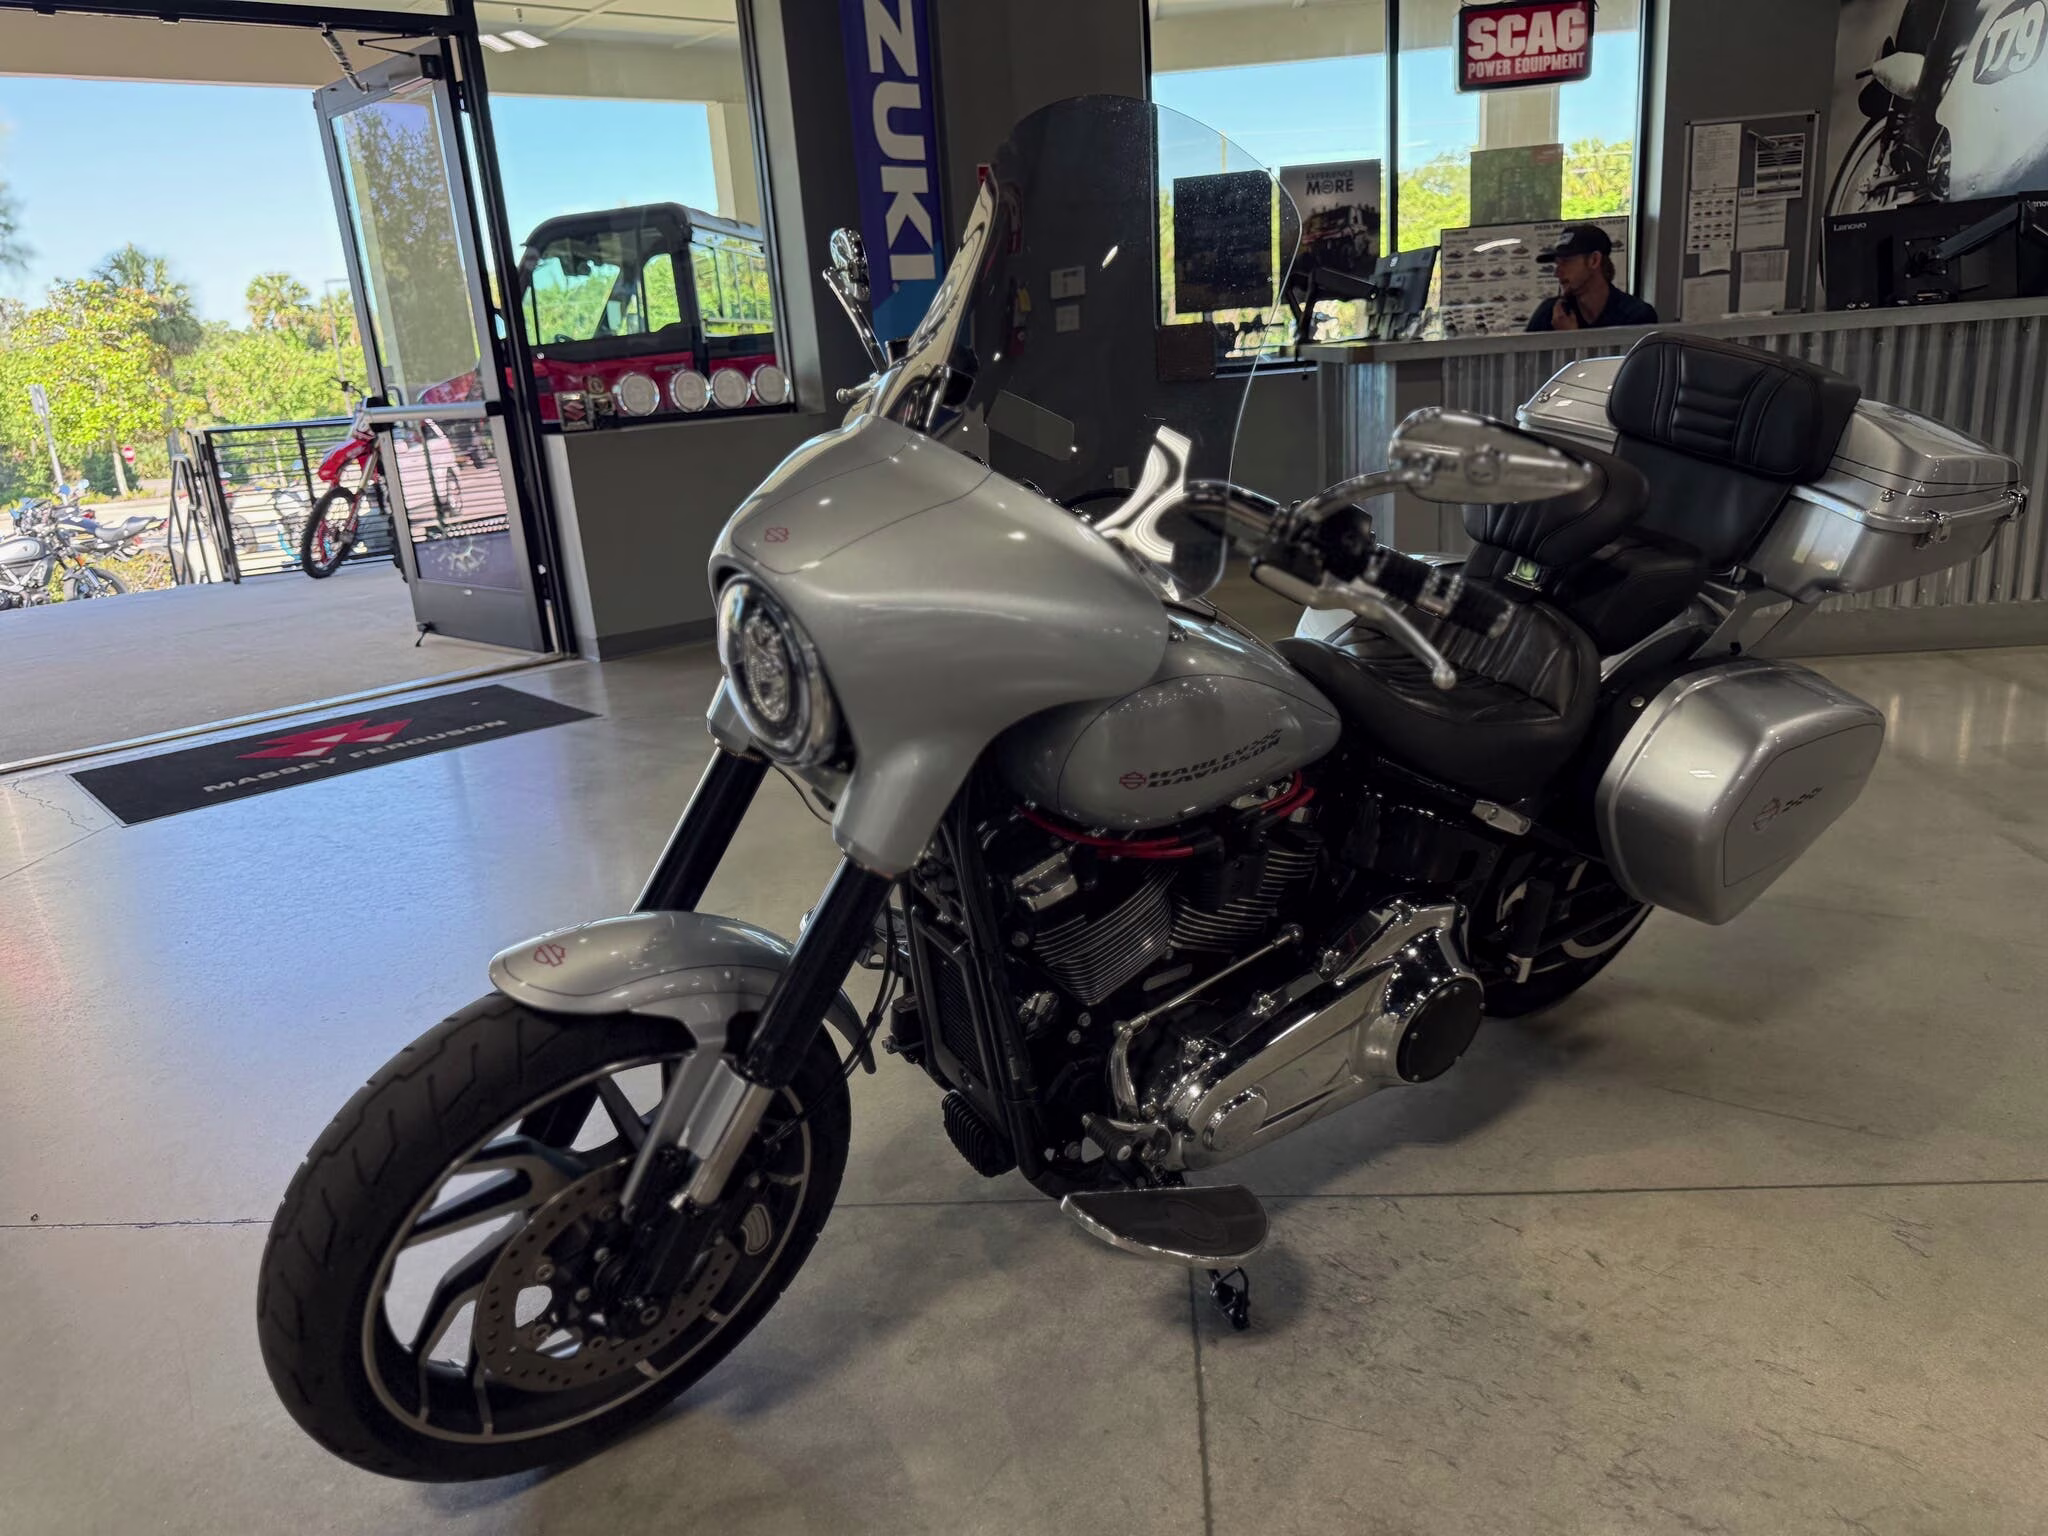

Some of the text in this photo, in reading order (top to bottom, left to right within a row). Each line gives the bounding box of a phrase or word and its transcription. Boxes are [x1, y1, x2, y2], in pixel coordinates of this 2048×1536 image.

[1467, 8, 1586, 60] SCAG
[1467, 52, 1585, 79] POWER EQUIPMENT
[862, 0, 936, 281] ZUKI
[1306, 179, 1354, 196] MORE
[1833, 221, 1867, 232] Lenovo
[203, 719, 508, 793] MASSEY FERGUSON
[1148, 737, 1281, 788] DAVIDSON
[1149, 745, 1250, 780] HARLEY
